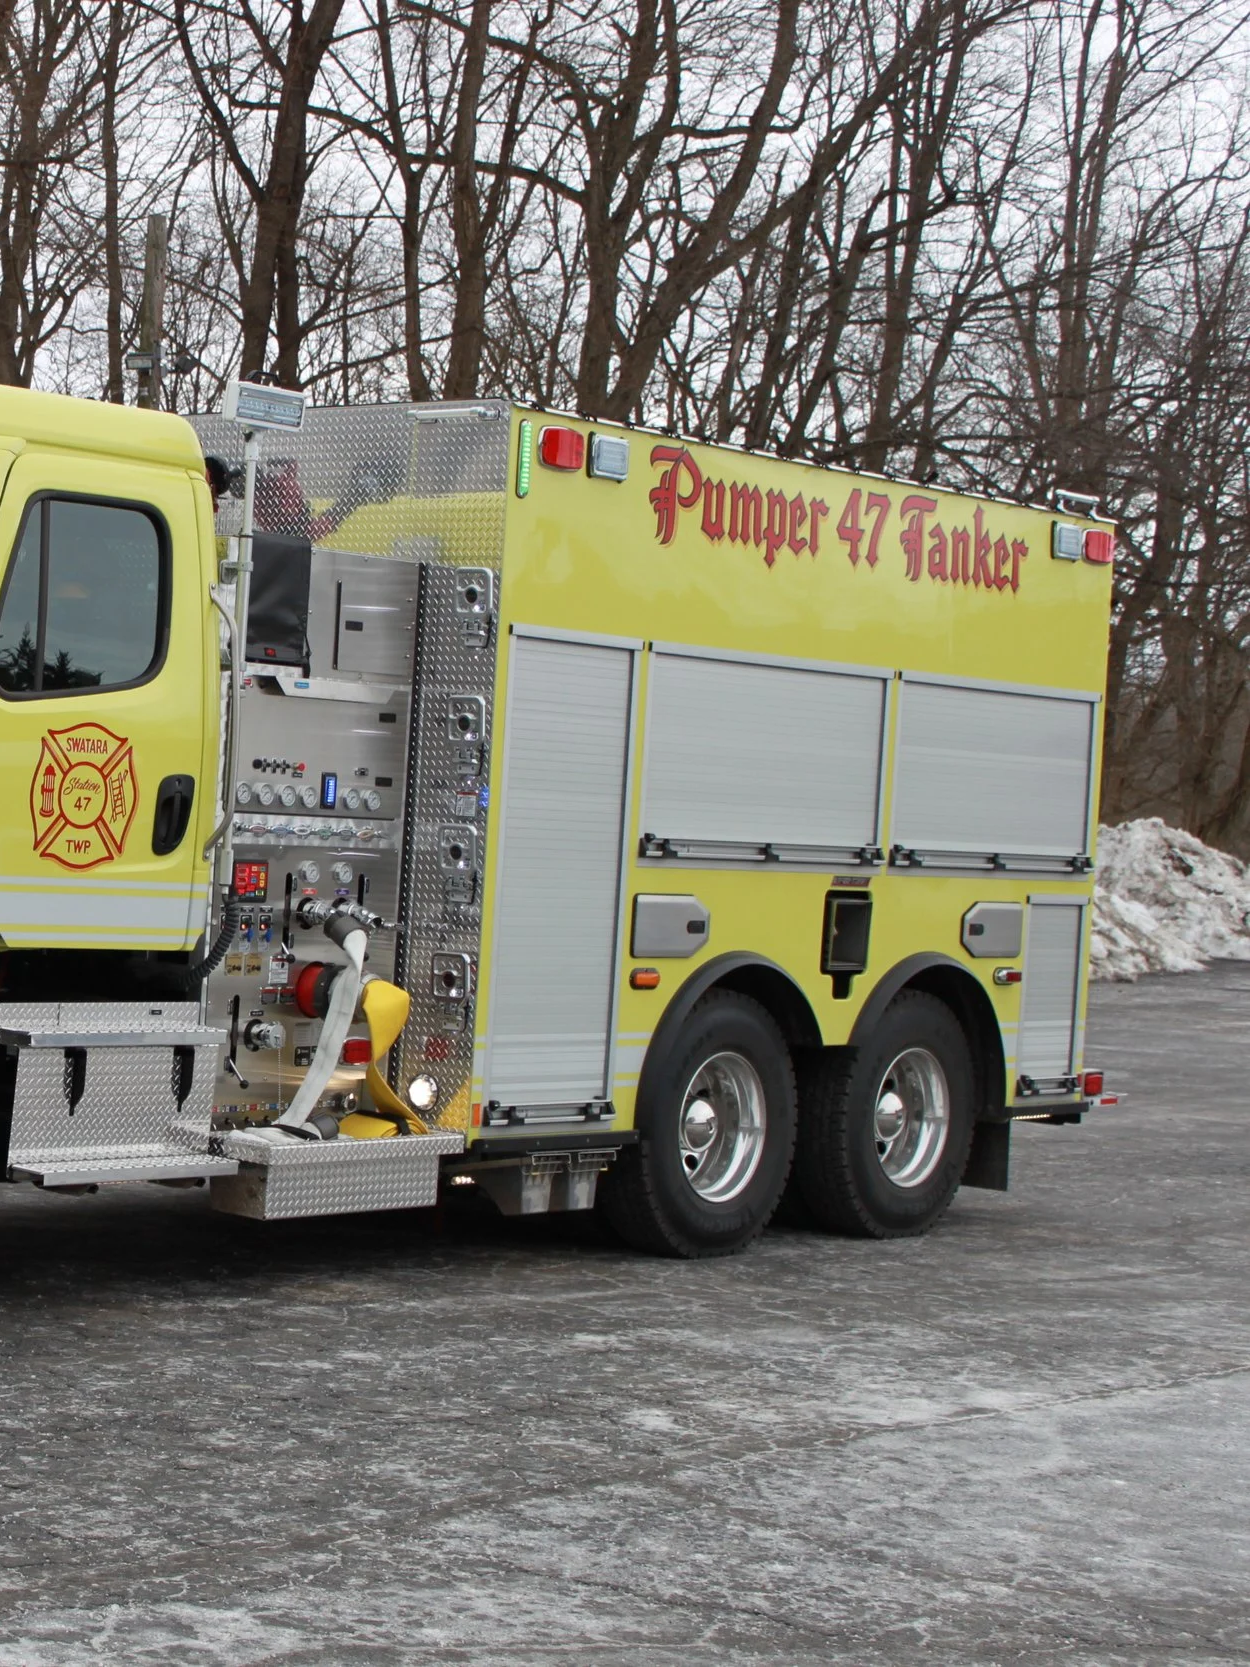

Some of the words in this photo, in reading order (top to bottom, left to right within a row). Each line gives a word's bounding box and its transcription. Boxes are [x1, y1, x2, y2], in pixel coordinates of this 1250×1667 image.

[649, 443, 830, 569] Pumper
[836, 487, 891, 568] 47
[899, 494, 1029, 595] Tanker
[66, 737, 109, 755] SWATARA
[63, 777, 102, 796] Station
[74, 797, 92, 812] 47
